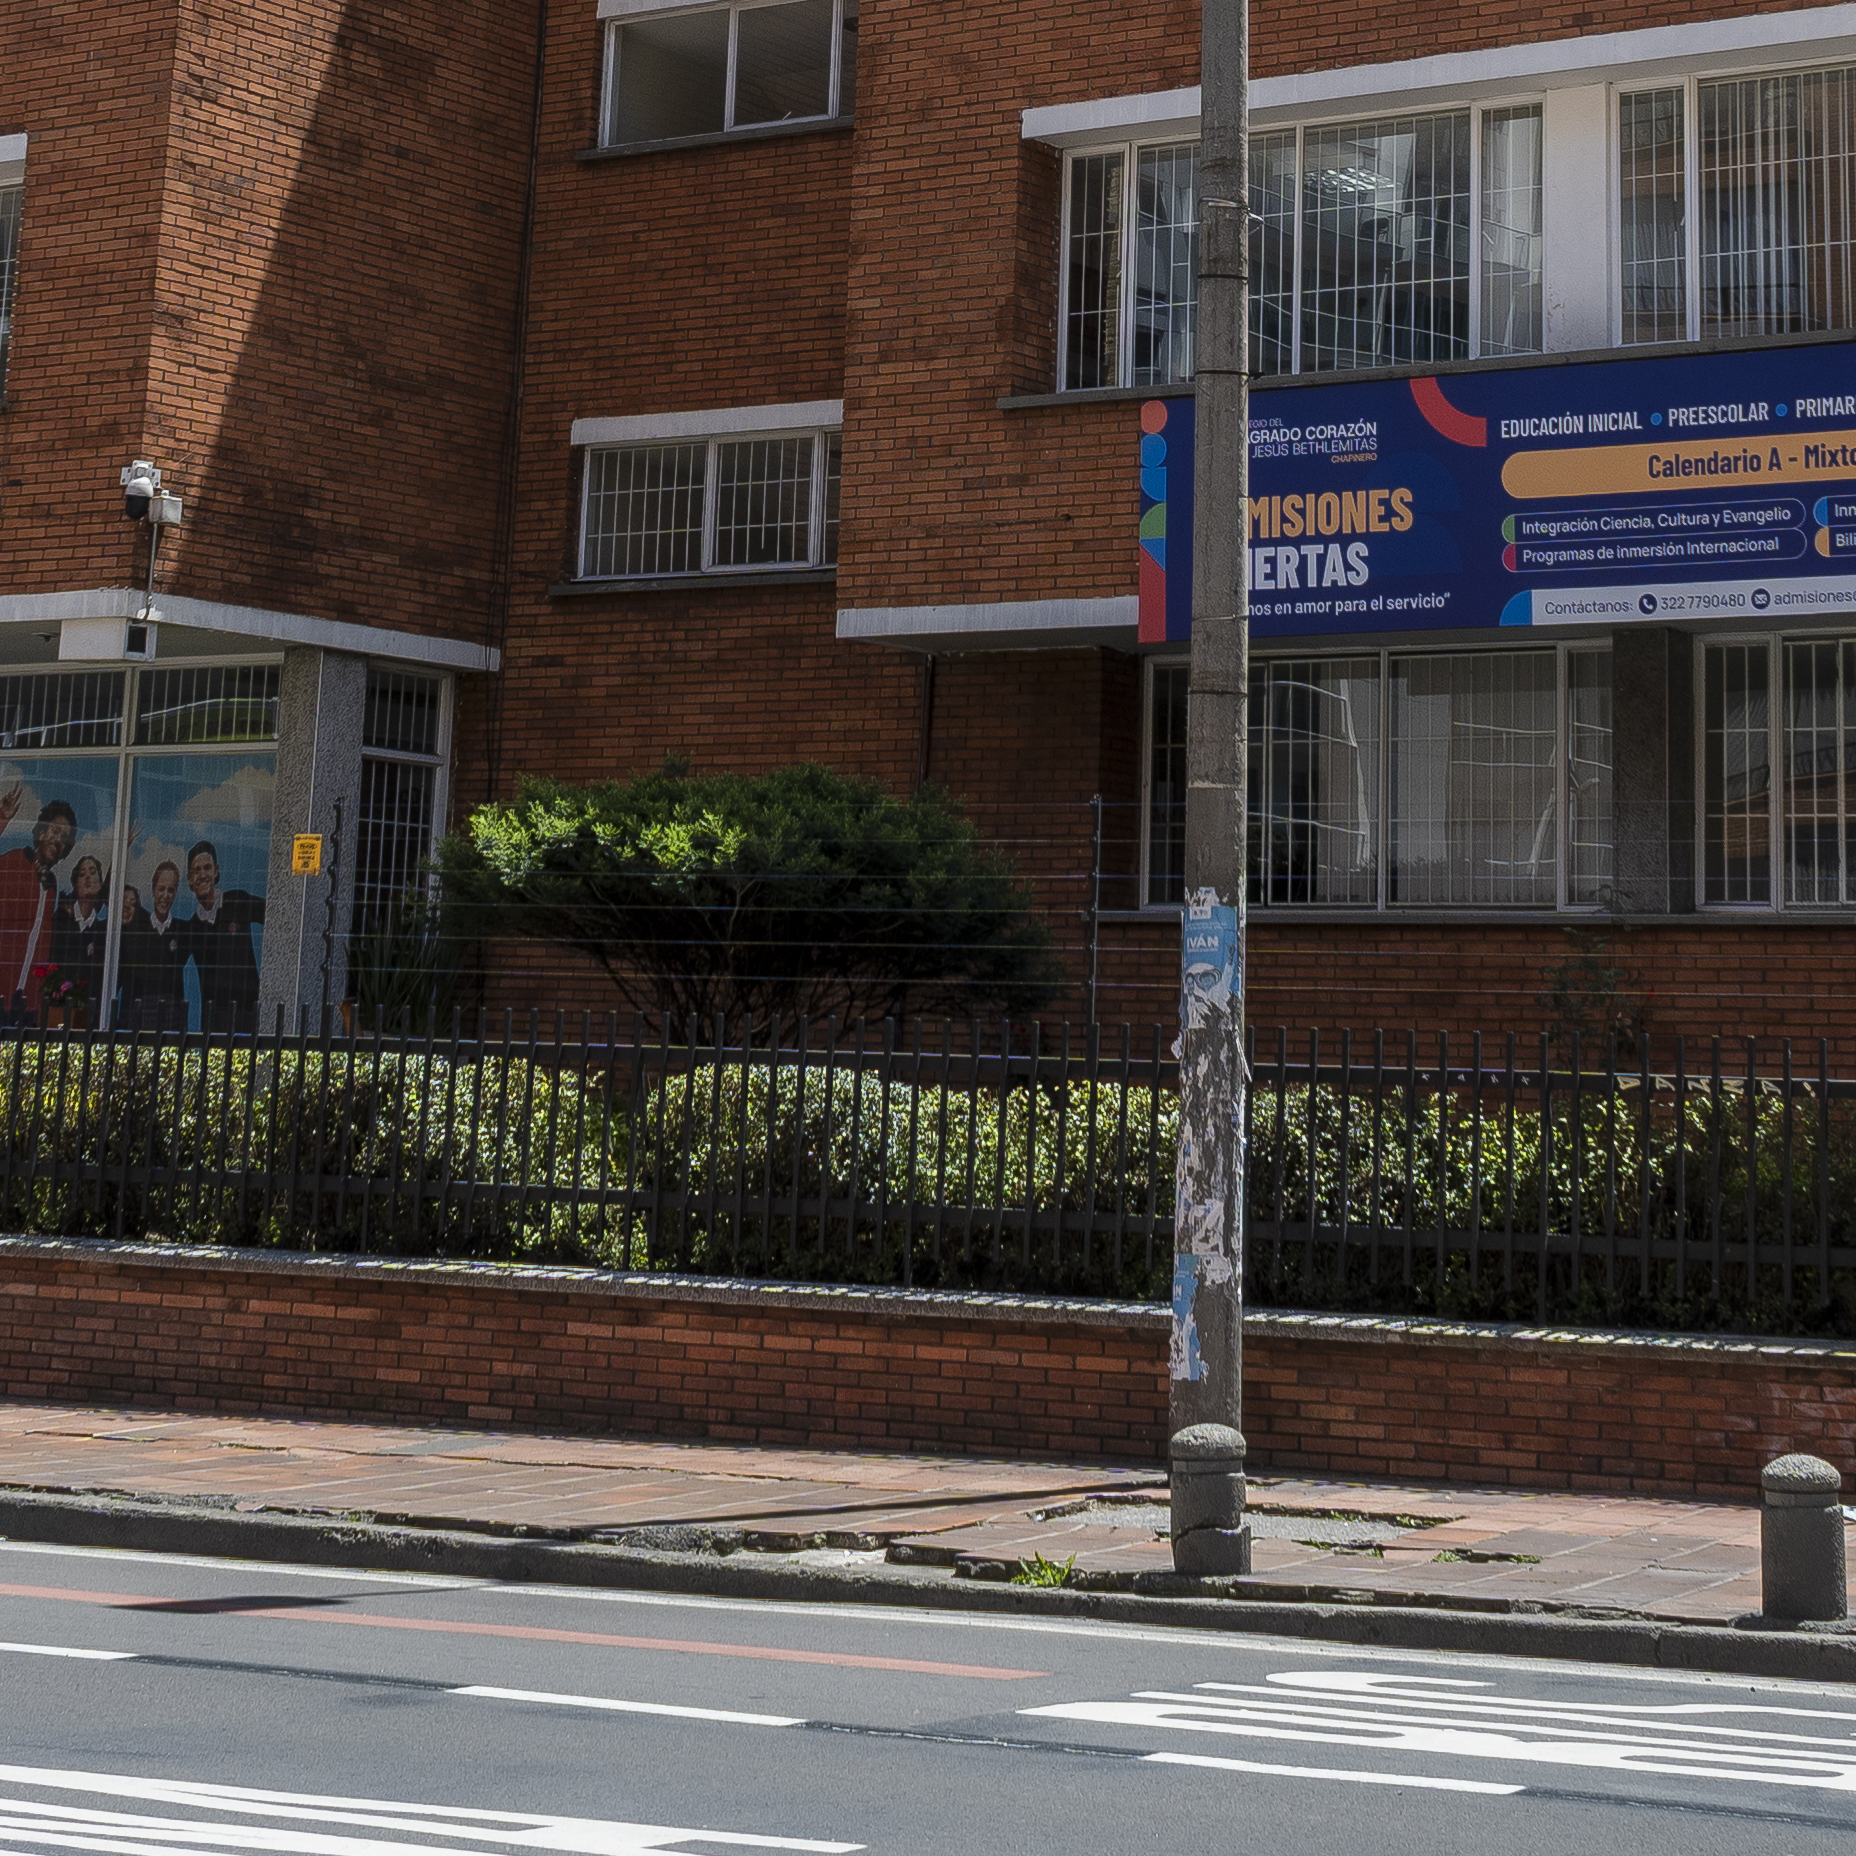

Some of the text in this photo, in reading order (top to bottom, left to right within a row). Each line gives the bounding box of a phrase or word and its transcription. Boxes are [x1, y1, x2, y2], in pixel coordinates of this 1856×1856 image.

[1247, 418, 1377, 445] GRADO CORAZÓN
[1248, 418, 1284, 428] EGIO DEL
[1501, 412, 1583, 438] EDUCACIÓN
[1588, 411, 1643, 433] INICIAL
[1668, 402, 1770, 427] PREESCOLAR
[1252, 438, 1377, 458] JESÚS BETHLEMITAS
[1331, 453, 1377, 463] CHAPINERO
[1648, 448, 1761, 479] Calendario
[1768, 446, 1782, 471] A
[1248, 488, 1413, 539] MISIONES
[1522, 506, 1791, 537] Integración Ciencia, Cultura y Evangelio
[1523, 535, 1780, 565] Programas de inmersión Internacional
[1248, 542, 1369, 591] IERTAS
[1275, 603, 1291, 615] en
[1295, 601, 1332, 614] amor
[1335, 599, 1367, 617] para
[1370, 594, 1383, 611] el
[1544, 597, 1633, 616] Contáctanos:
[1187, 934, 1219, 948] IVÁN
